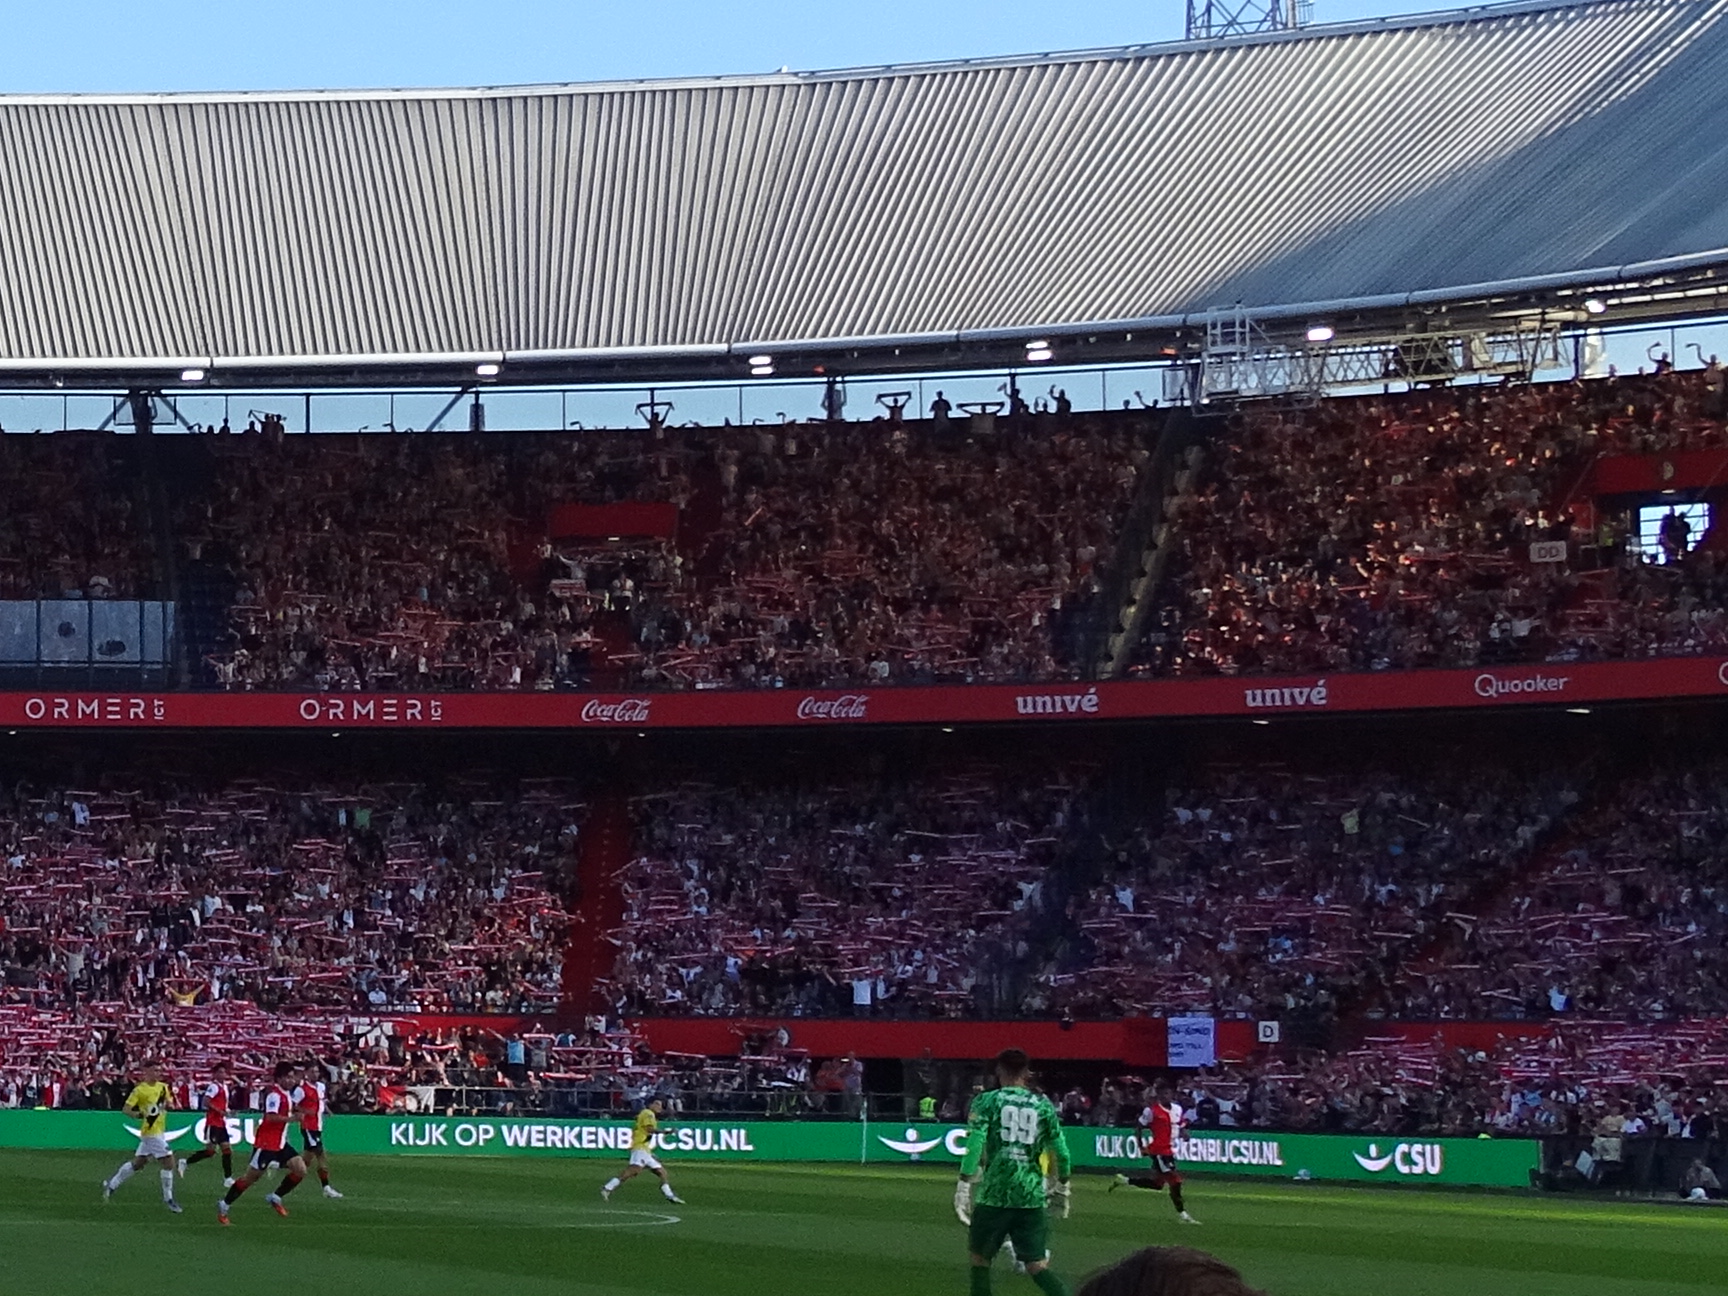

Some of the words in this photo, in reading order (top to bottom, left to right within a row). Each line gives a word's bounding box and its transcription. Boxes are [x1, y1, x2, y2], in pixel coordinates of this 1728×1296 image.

[1015, 686, 1100, 714] univé
[1244, 679, 1328, 707] univé
[1474, 674, 1571, 698] Quooker
[25, 697, 145, 720] ORMER
[299, 699, 423, 721] ORMER
[390, 1122, 447, 1147] KIJK
[455, 1122, 495, 1147] OP
[502, 1124, 754, 1151] WERKENBJCSU.NL
[1001, 1105, 1038, 1145] 99
[1095, 1134, 1124, 1158] KIJK
[1394, 1143, 1442, 1175] CSU
